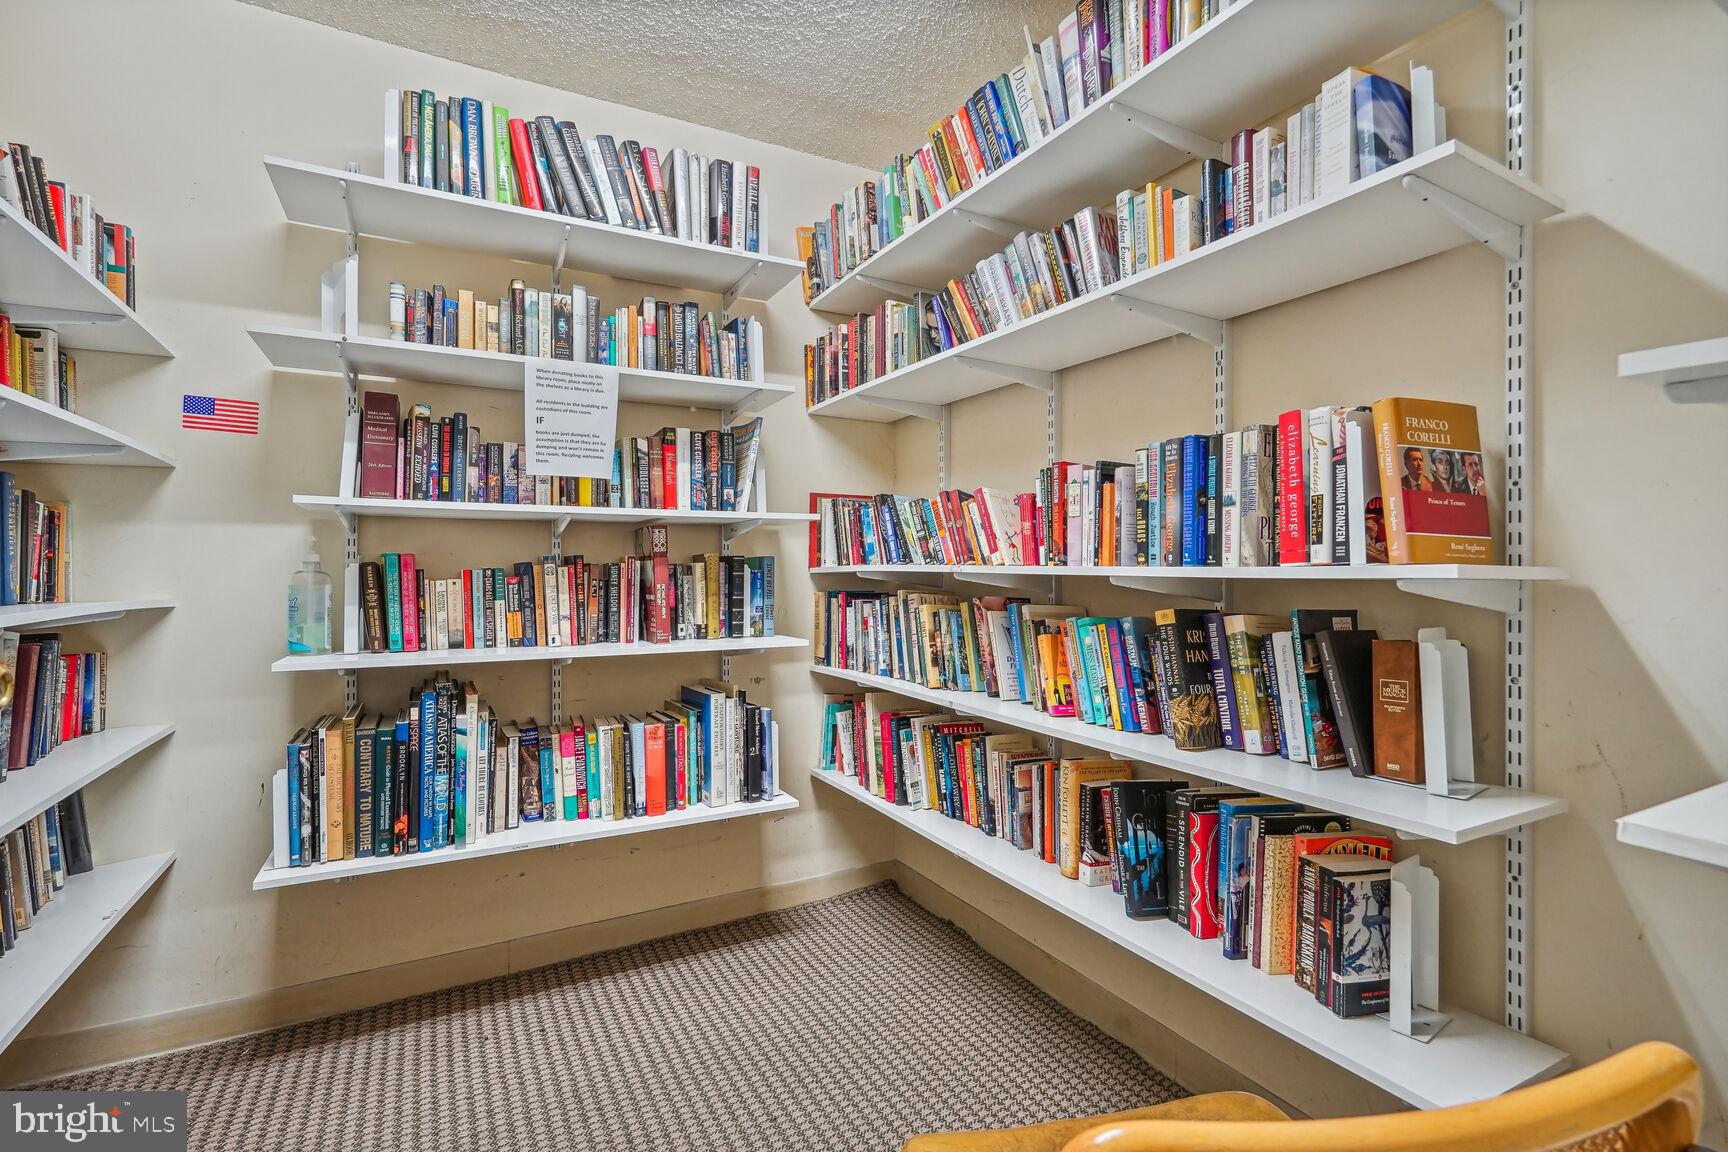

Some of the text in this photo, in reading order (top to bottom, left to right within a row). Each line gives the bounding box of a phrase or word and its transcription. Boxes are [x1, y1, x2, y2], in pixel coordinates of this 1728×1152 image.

[1011, 66, 1032, 113] Dutch
[467, 101, 480, 159] DAN BROWN
[749, 176, 759, 207] PERIL
[987, 260, 1003, 295] RUSSELL
[515, 314, 525, 337] Richard
[675, 312, 684, 365] DAVID BALDACCI
[551, 369, 573, 378] donating
[368, 433, 394, 442] Dictionary
[431, 424, 439, 438] CLIVE
[536, 416, 545, 424] IF
[1406, 416, 1448, 431] FRANCO
[694, 432, 703, 478] CLIVE CUSSLER
[1382, 421, 1393, 477] FRANCO CORELLI
[1407, 432, 1451, 445] CORELLI
[414, 454, 423, 484] ECHOED
[1287, 423, 1300, 540] elizabeth george
[1311, 432, 1328, 497] Learning
[1165, 462, 1178, 552] Elizabeth George
[1334, 464, 1346, 542] JONATHAN FRANZEN
[1428, 497, 1466, 507] Prince of Tenors
[1136, 520, 1146, 544] ROADS
[1150, 501, 1159, 549] Rough Justice
[1451, 542, 1486, 552] René Seghers
[1127, 635, 1135, 658] DEATH
[1161, 641, 1170, 661] FOUR
[1166, 626, 1180, 685] KRISTIN HANNAH
[1229, 640, 1238, 669] PALACE
[1234, 634, 1246, 676] THE PAPER
[1291, 616, 1299, 639] ANTIQUE
[1297, 654, 1307, 692] RESTORATION
[1085, 644, 1101, 696] MISS MARPLE
[1165, 662, 1174, 686] WINDS
[1260, 650, 1271, 690] ELEVATION
[1213, 667, 1232, 732] TOTAL CONTROL
[1242, 690, 1250, 716] MIRANDA
[1382, 687, 1407, 695] MERCK
[1239, 704, 1247, 727] HELLER
[1268, 696, 1278, 729] STEPHEN
[409, 728, 419, 752] SPACE
[424, 698, 435, 774] ATLAS OF AMERICA
[398, 745, 406, 781] BROOKLYN
[435, 716, 448, 811] ATLAS OF THE WORLD
[574, 735, 587, 790] JANET EVANOVICH
[964, 747, 972, 774] DEWEY
[1386, 762, 1400, 770] MSD
[359, 738, 372, 851] CONTRARY TO NATURE
[938, 768, 946, 794] KARMA
[948, 753, 960, 807] LOIS LOWRY
[1061, 765, 1070, 825] KEN FOLLETT
[1112, 786, 1120, 805] JOHN
[1114, 805, 1123, 838] GRISHAM
[1220, 823, 1228, 865] Hilderbrand
[1118, 854, 1129, 898] JUDGE'S LIST
[1177, 819, 1187, 912] SPLENDID VILE
[1300, 863, 1317, 972] ANNIE PROULX BARKSKINS
